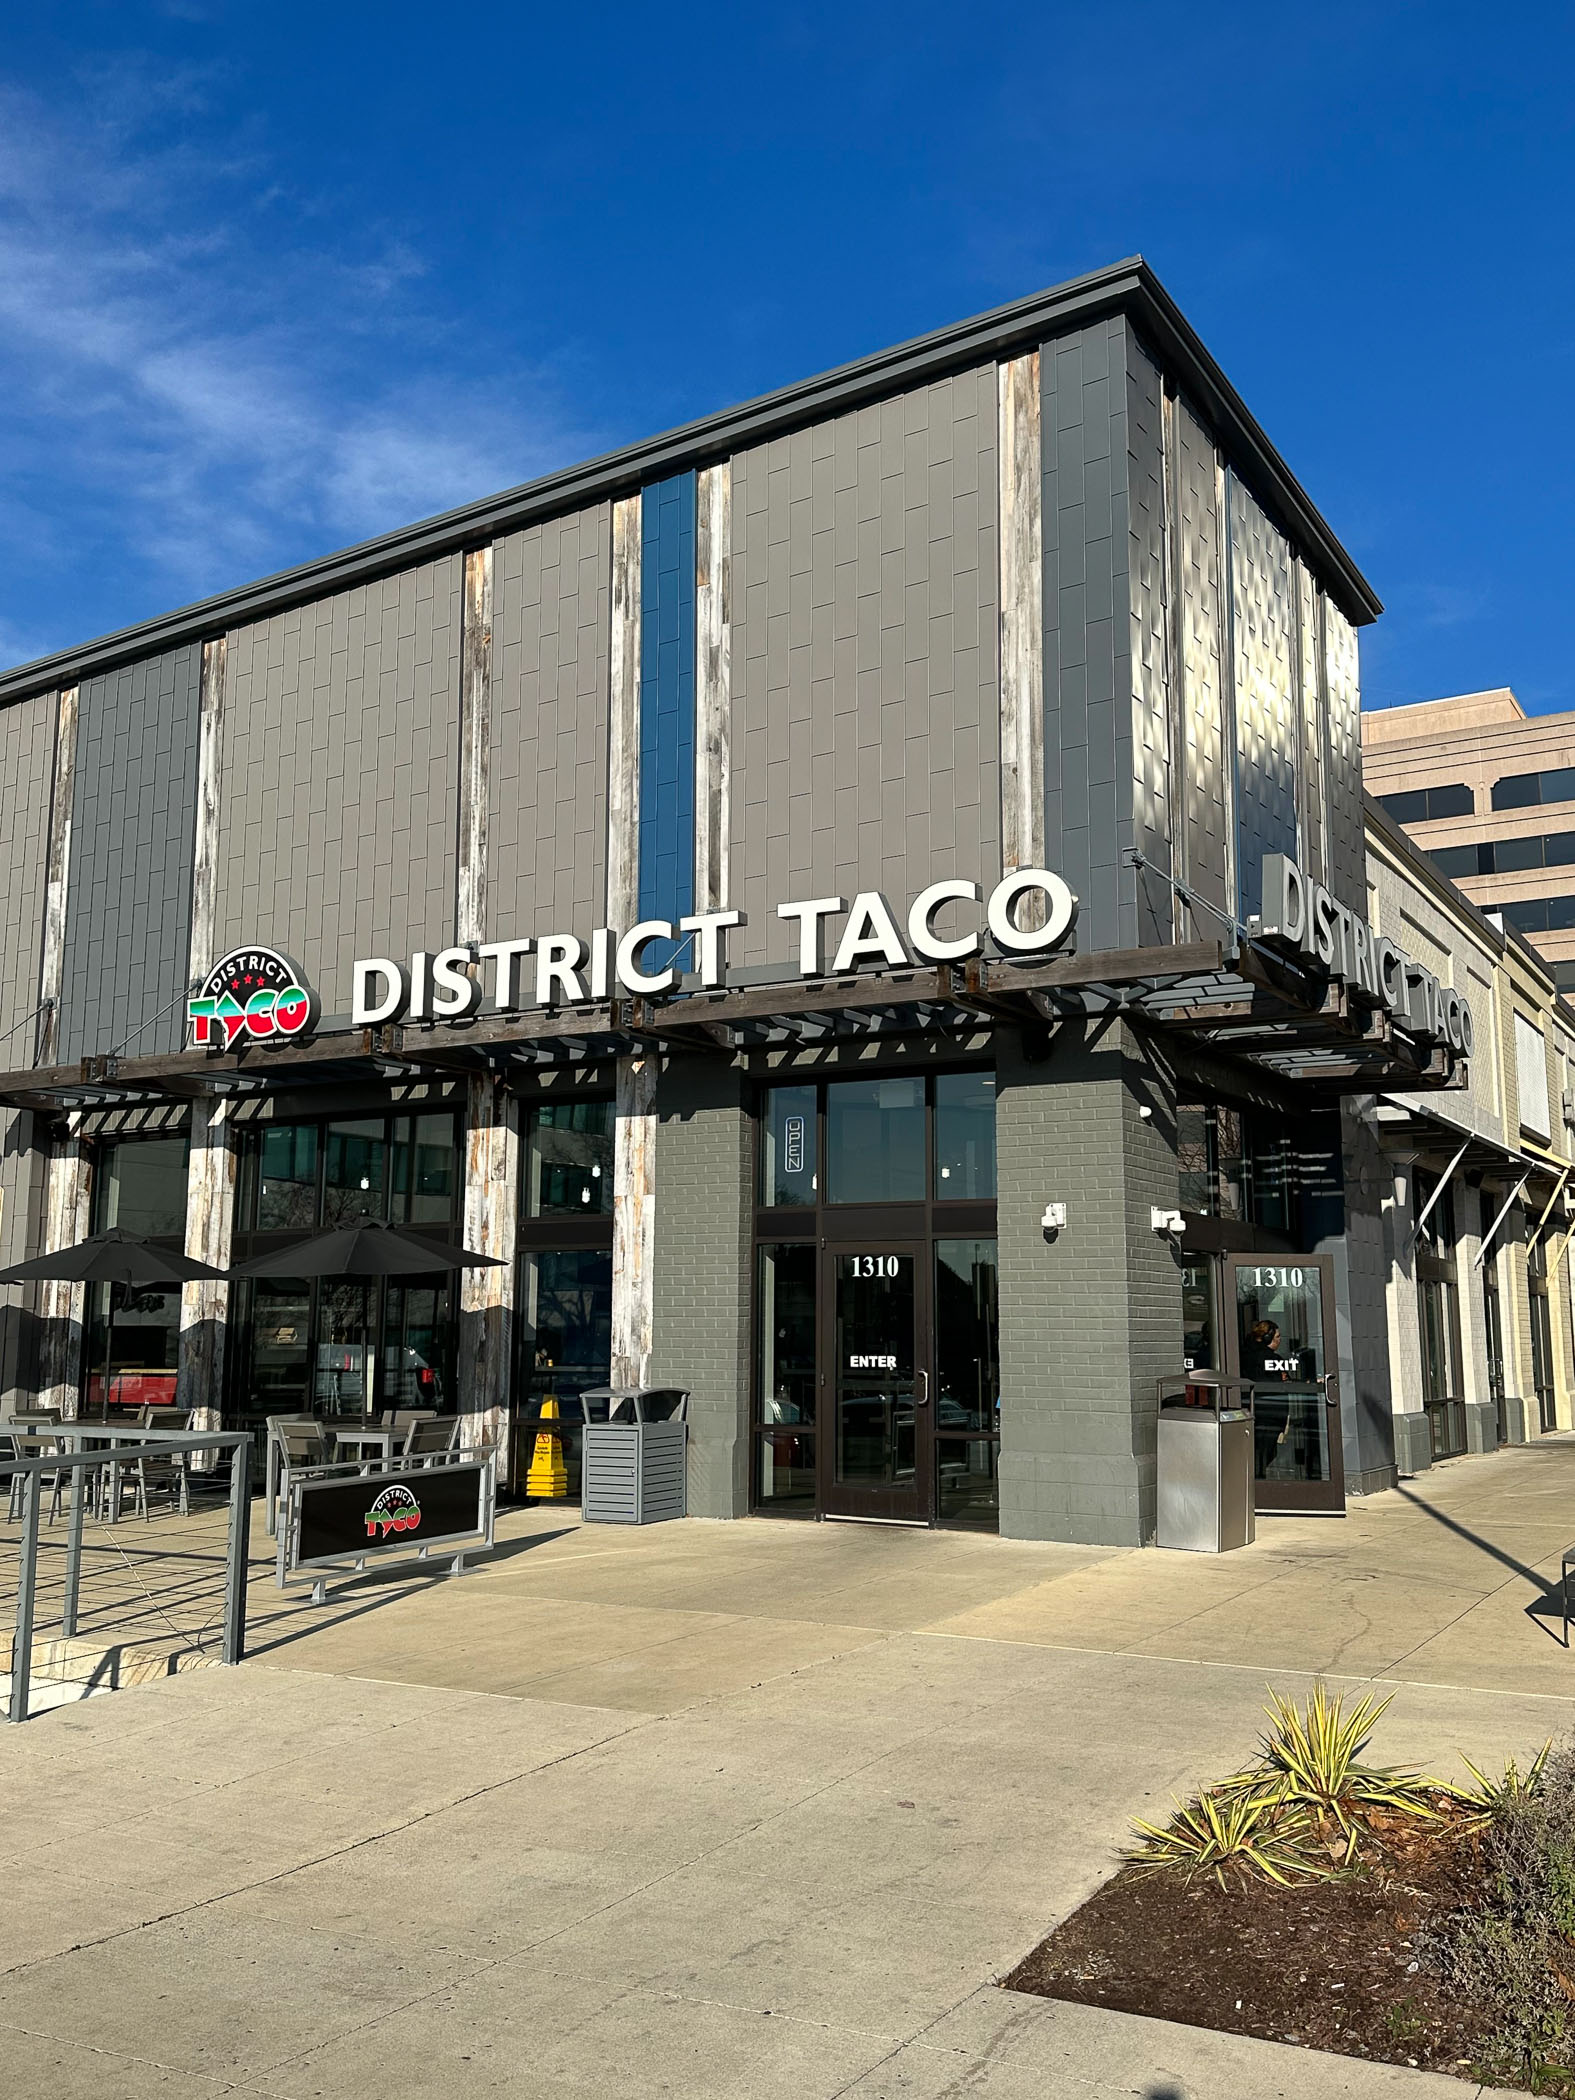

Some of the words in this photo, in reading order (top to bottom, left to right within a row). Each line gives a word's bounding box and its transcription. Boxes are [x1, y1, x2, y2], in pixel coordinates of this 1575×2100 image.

[351, 910, 742, 1026] DISTRICT
[777, 868, 1075, 976] TACO
[1281, 853, 1411, 1018] DISTRICT
[1406, 963, 1474, 1058] TACO
[210, 955, 288, 994] DISTRICT
[187, 984, 311, 1052] TACO
[788, 1119, 801, 1170] OPEN
[851, 1255, 900, 1278] 1310
[1252, 1266, 1304, 1288] 1310
[849, 1355, 898, 1369] ENTER
[1264, 1357, 1300, 1372] EXIT
[376, 1489, 412, 1510] DISTRICT
[364, 1505, 421, 1539] TACO
